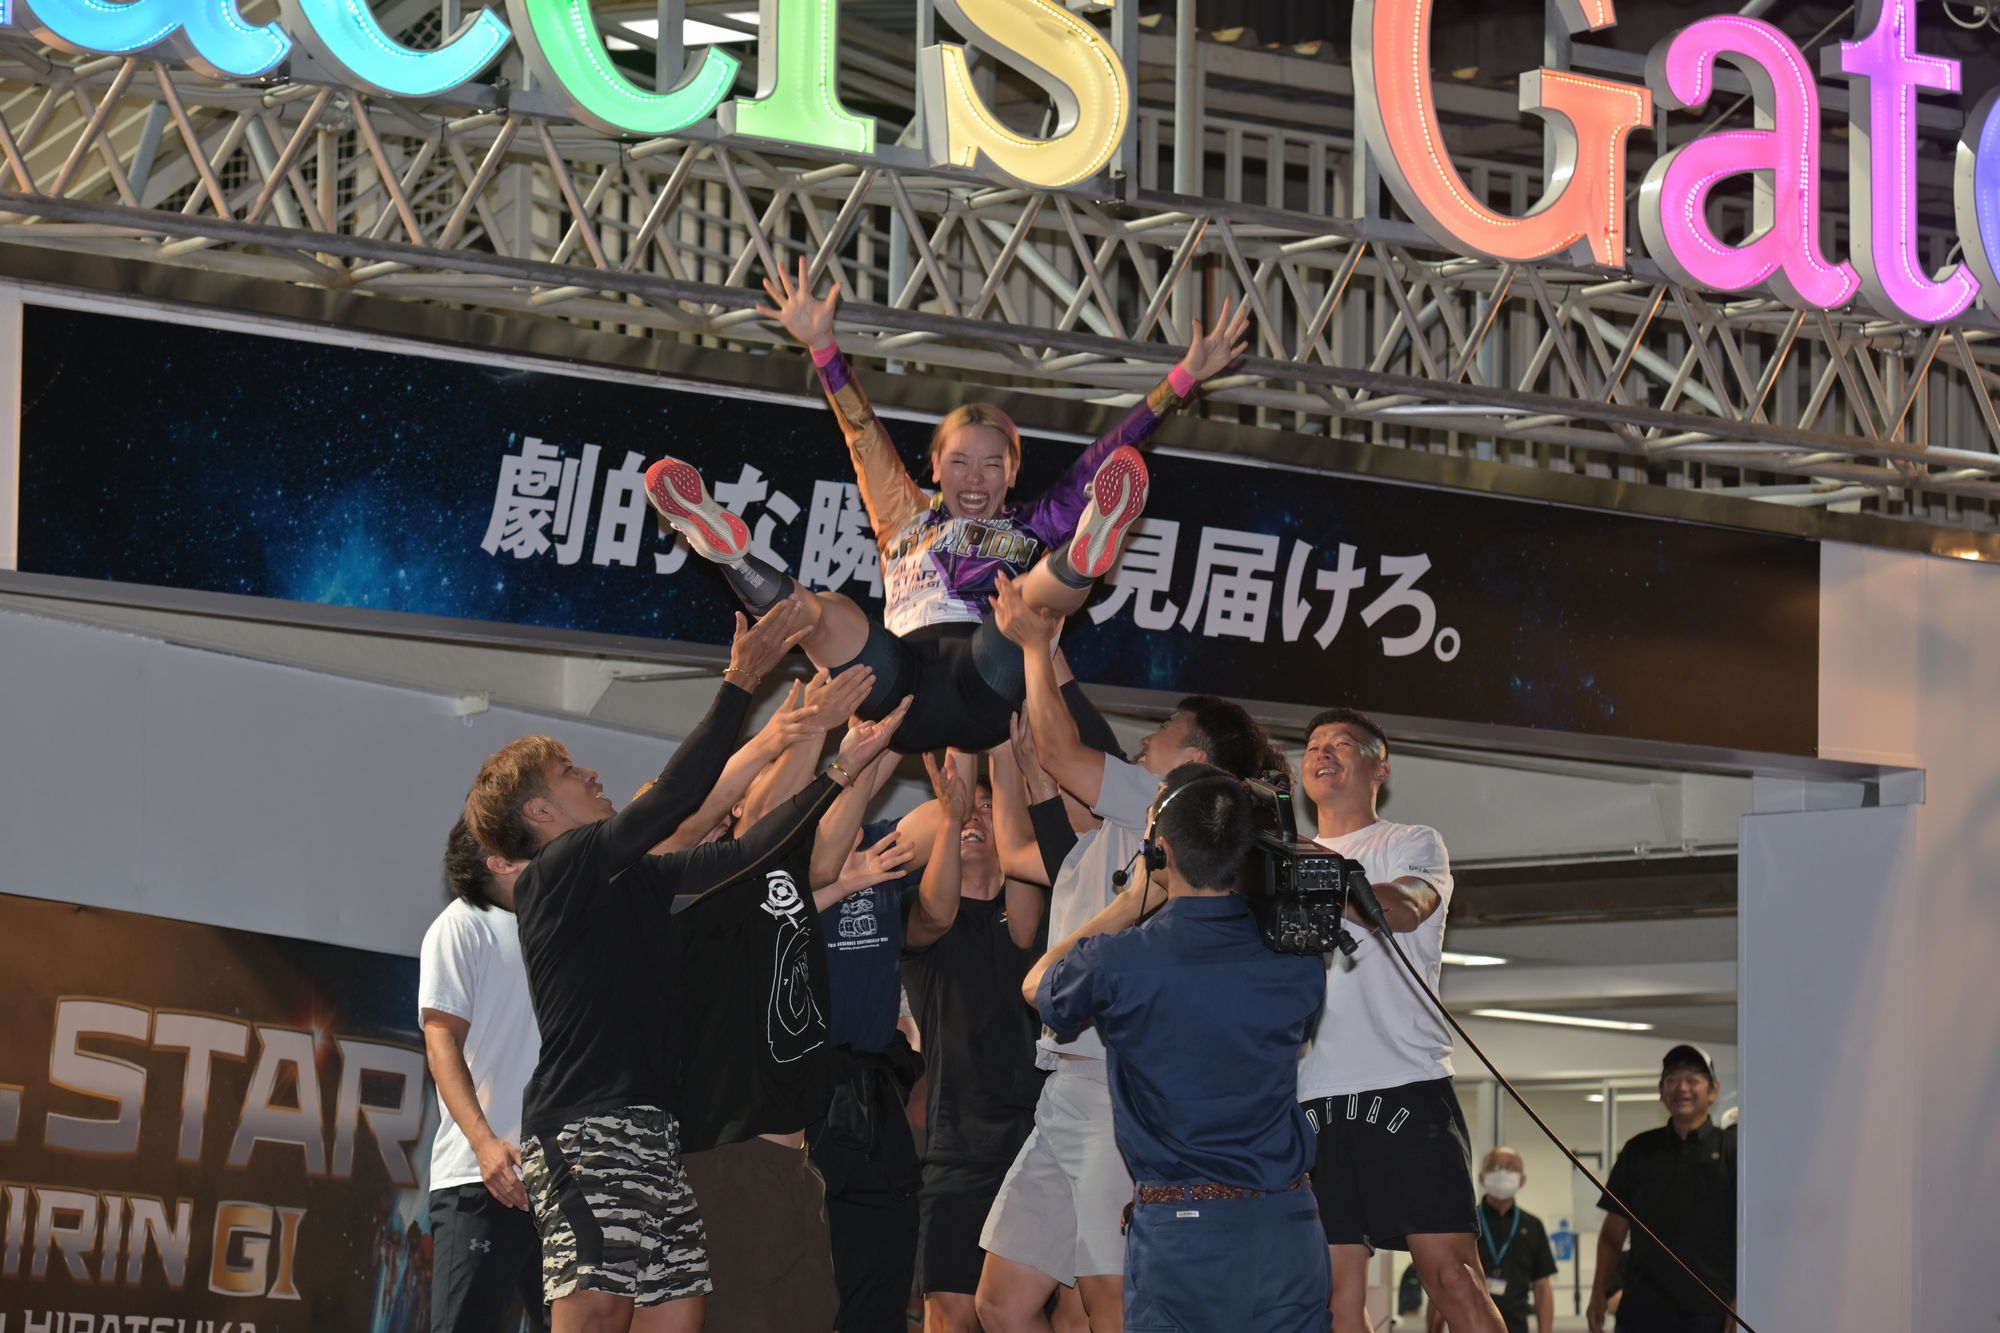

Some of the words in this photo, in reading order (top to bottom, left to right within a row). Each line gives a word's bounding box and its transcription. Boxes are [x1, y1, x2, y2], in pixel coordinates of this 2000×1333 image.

[1357, 0, 2000, 322] Gat
[45, 996, 426, 1188] STAR
[0, 1182, 194, 1290] IRIN
